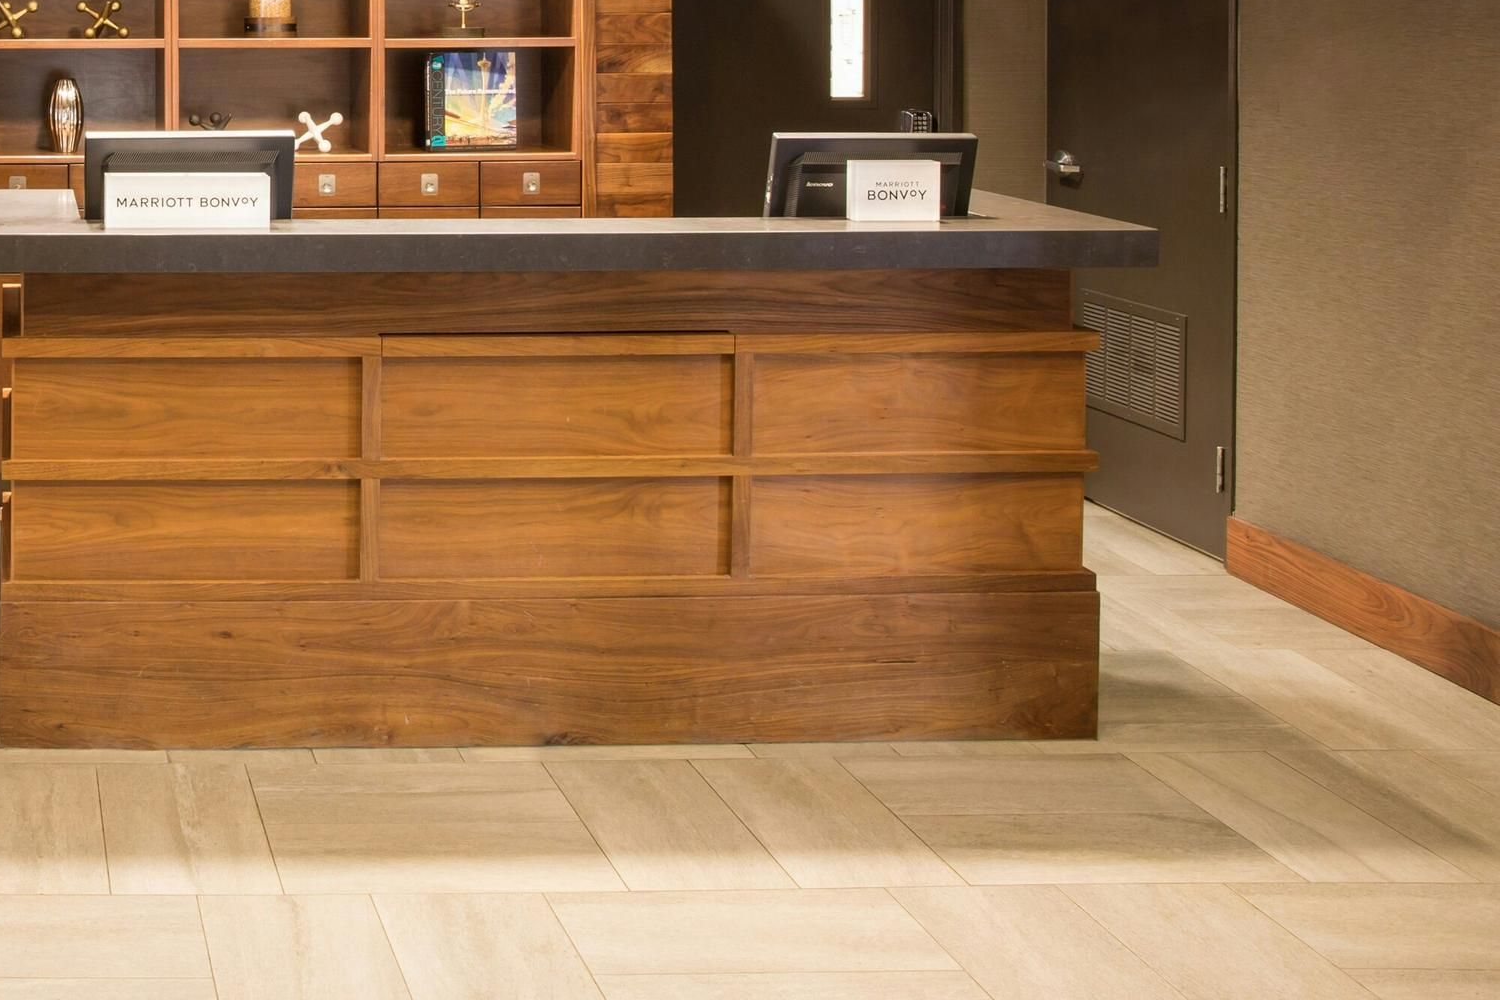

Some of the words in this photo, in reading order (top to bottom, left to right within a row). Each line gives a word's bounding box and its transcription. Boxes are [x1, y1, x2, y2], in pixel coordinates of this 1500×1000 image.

[432, 70, 445, 136] CENTURY
[867, 190, 927, 201] BONVOY
[116, 197, 193, 208] MARRIOTT
[200, 196, 259, 208] BONVOY
